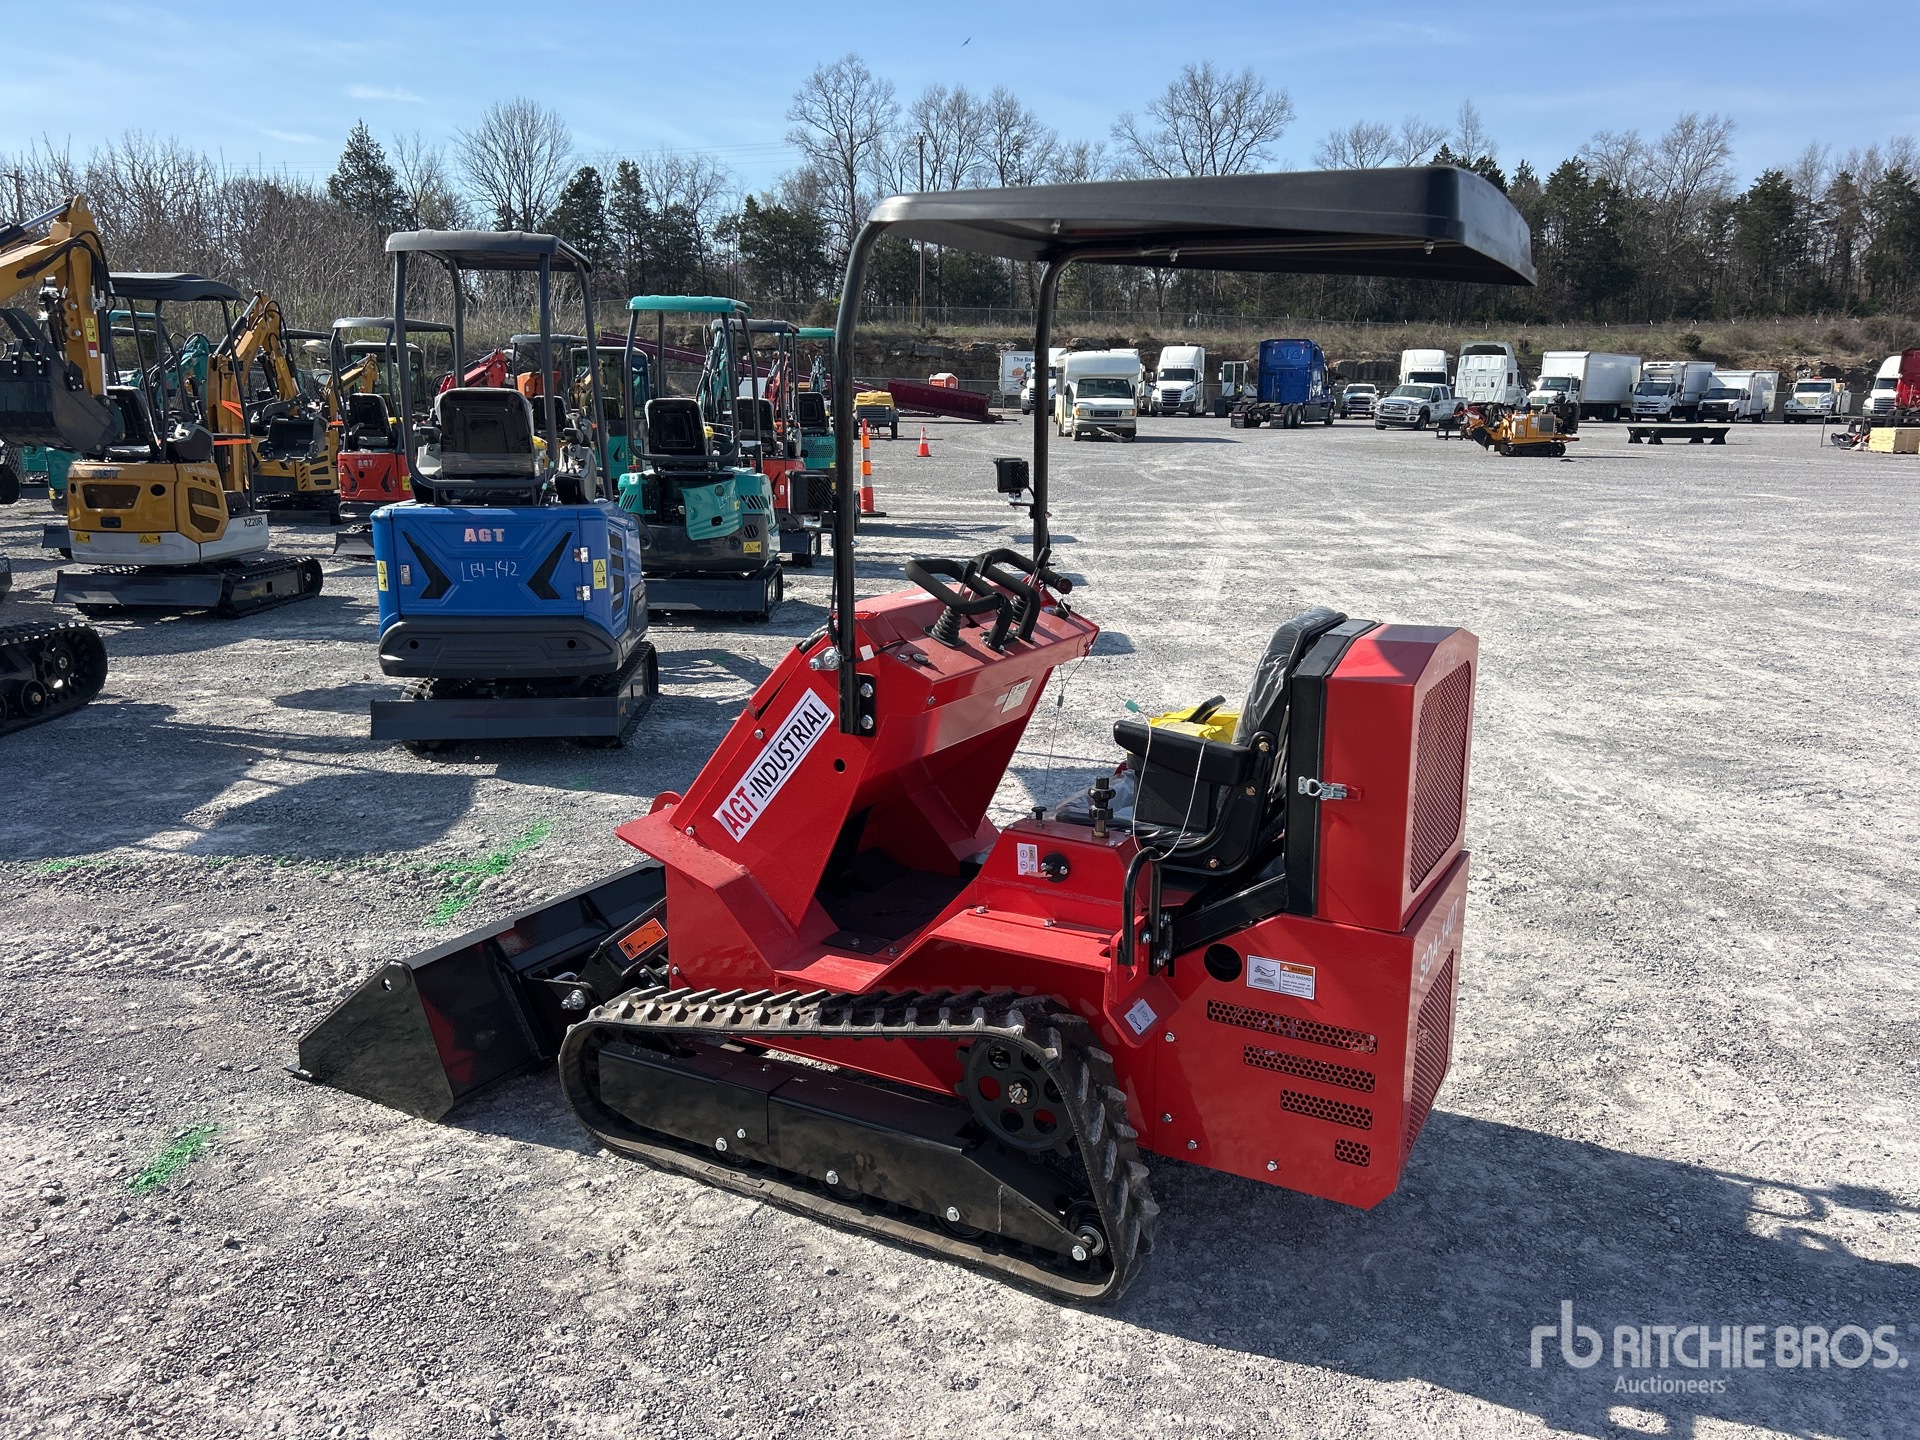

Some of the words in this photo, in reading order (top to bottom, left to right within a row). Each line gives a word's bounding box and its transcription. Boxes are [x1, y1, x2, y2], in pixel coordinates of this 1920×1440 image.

[243, 516, 264, 528] XZ20R
[463, 528, 505, 543] AGT
[460, 558, 520, 582] LE4-142
[720, 785, 759, 837] AGT
[1282, 972, 1296, 980] SCALD
[1291, 966, 1312, 975] WARNING
